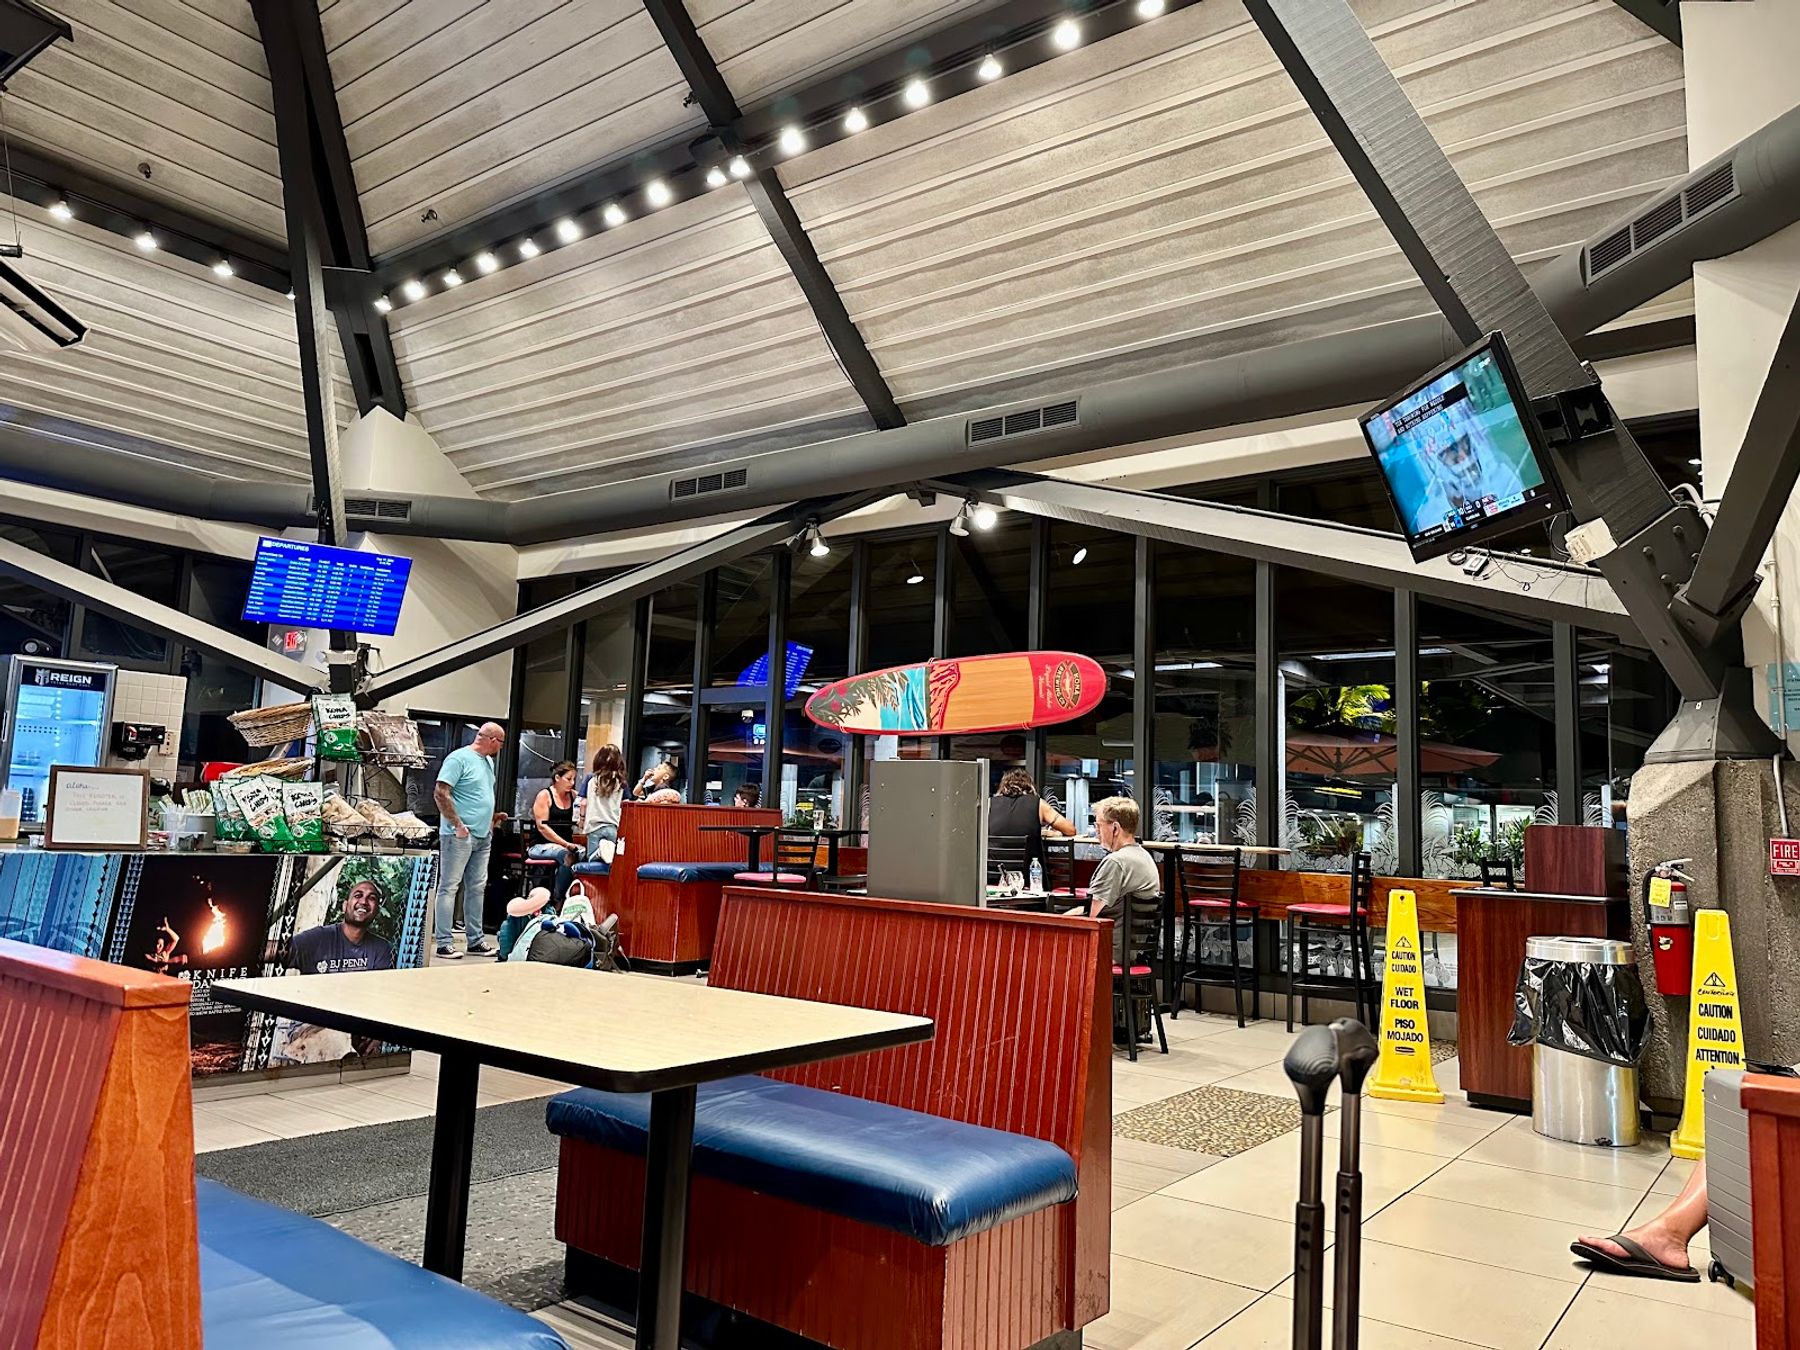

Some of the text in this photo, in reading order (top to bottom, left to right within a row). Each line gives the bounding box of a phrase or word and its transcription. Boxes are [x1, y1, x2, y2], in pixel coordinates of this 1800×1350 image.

[50, 672, 92, 684] REIGN
[1773, 844, 1798, 858] FIRE
[1392, 951, 1416, 960] CAUTION
[330, 958, 368, 968] BJ PENN
[1392, 964, 1416, 973] CUIDADO
[193, 967, 248, 979] KNIFE
[1395, 987, 1414, 997] WET
[1390, 999, 1419, 1010] FLOOR
[1699, 1003, 1733, 1019] CAUTION
[1395, 1018, 1415, 1029] PISO
[1387, 1031, 1424, 1042] MOJADO
[1698, 1027, 1736, 1042] CUIDADO
[1696, 1049, 1740, 1064] ATTENTION
